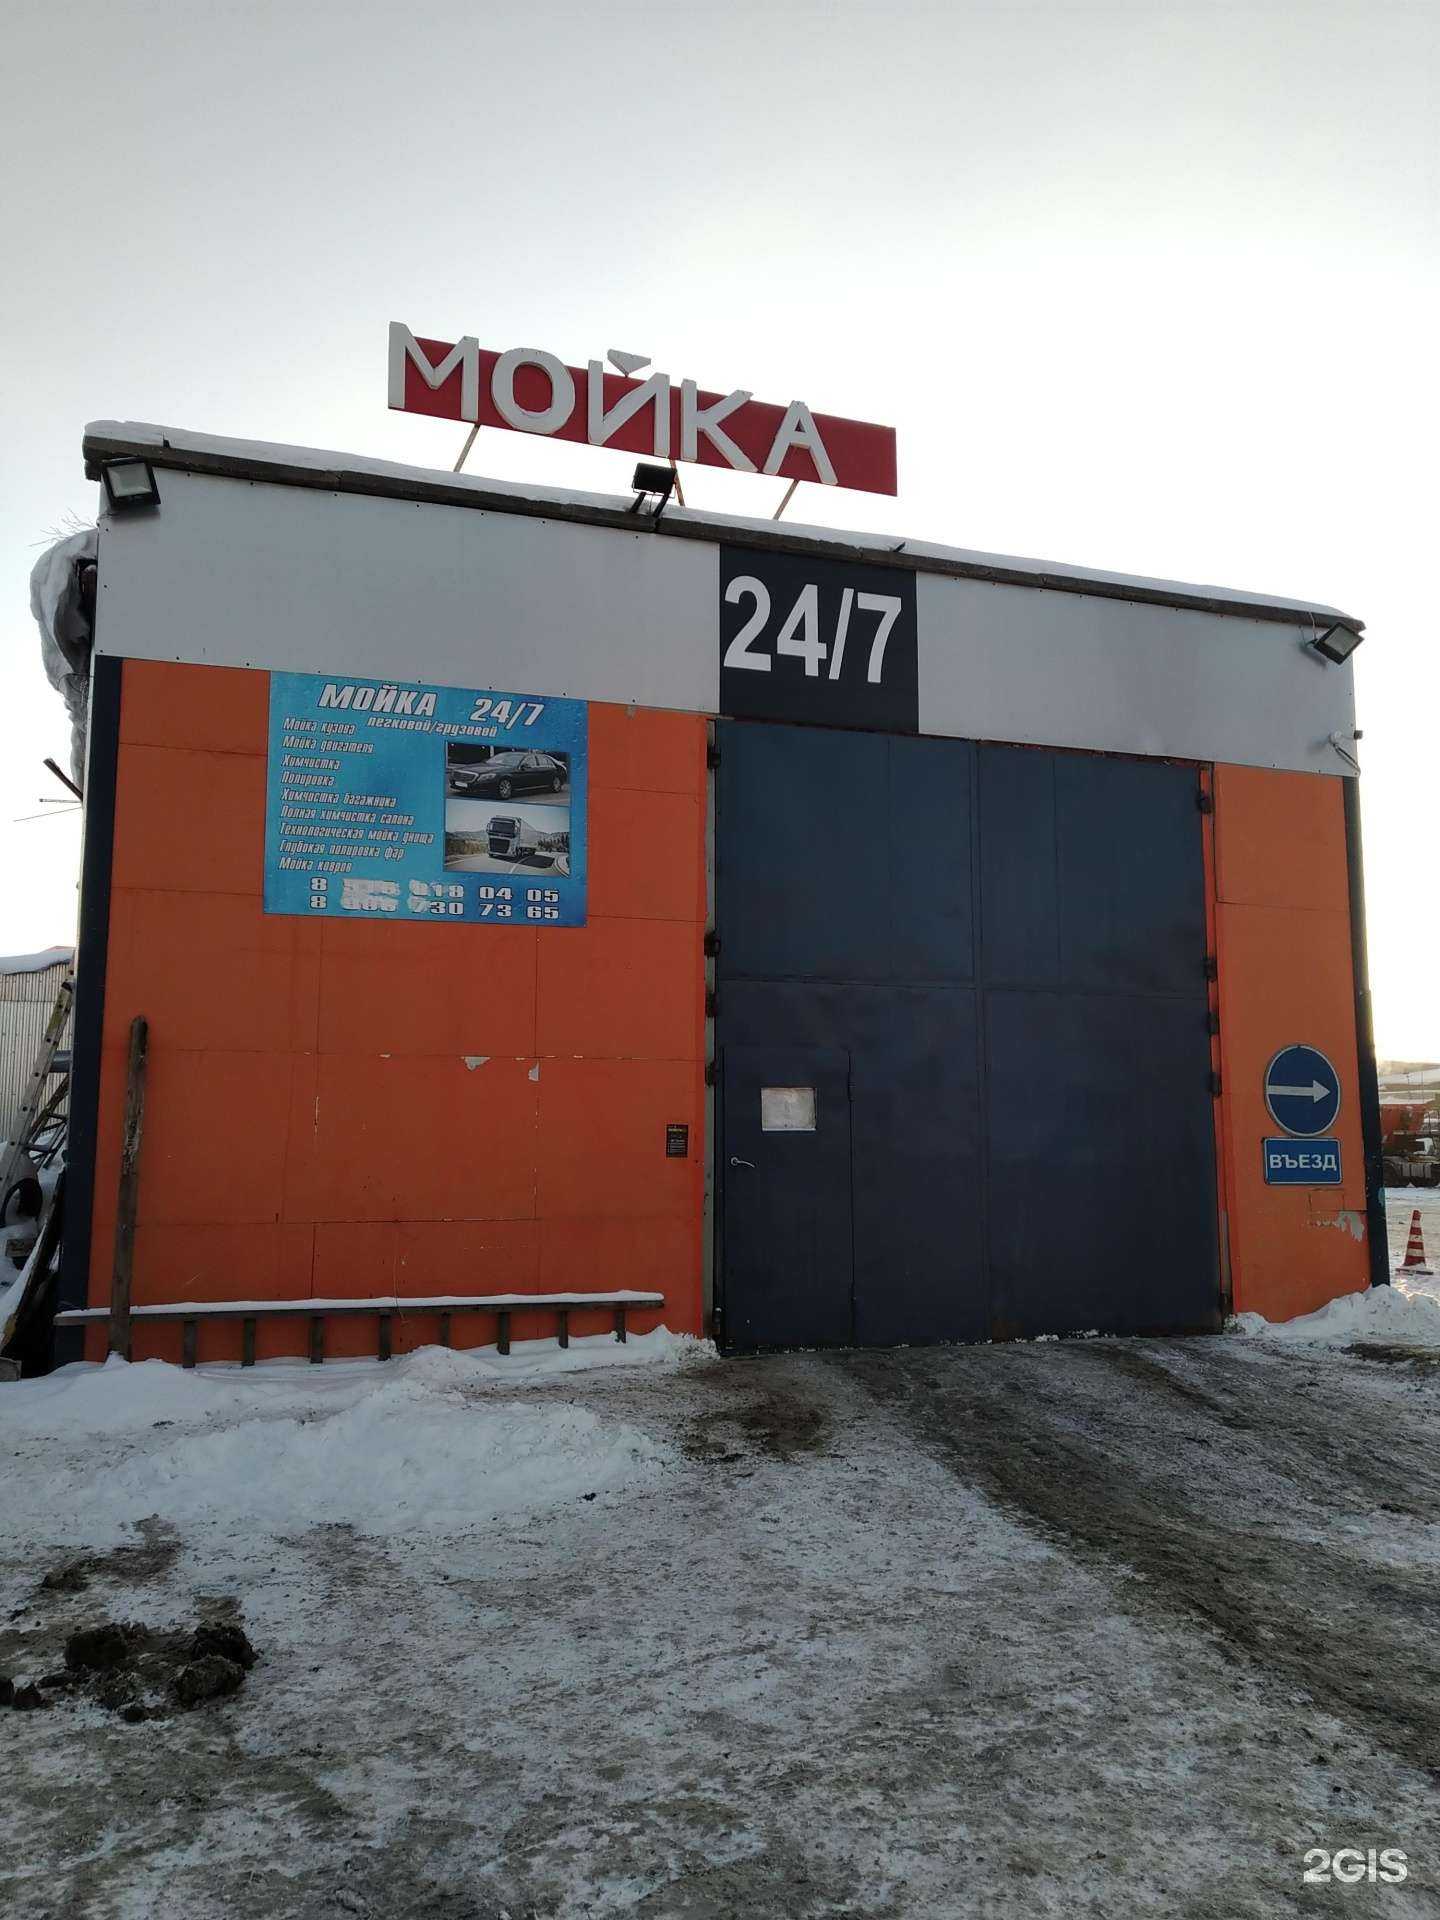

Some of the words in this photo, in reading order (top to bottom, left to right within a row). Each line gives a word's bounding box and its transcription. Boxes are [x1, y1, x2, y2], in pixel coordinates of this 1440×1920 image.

[388, 321, 838, 485] МОЙКА
[723, 575, 902, 683] 24/7
[318, 683, 438, 717] МОЙКА
[469, 698, 544, 730] 24/7
[283, 717, 317, 733] Мойка
[282, 735, 317, 750] Мойка
[384, 845, 405, 862] фар
[278, 857, 314, 872] Мойка
[310, 877, 328, 892] 8
[479, 886, 512, 900] 04
[527, 889, 559, 903] 05
[310, 895, 328, 910] 8
[479, 903, 512, 917] 73
[527, 905, 559, 919] 65
[1269, 1154, 1337, 1171] ВЪЕЗД
